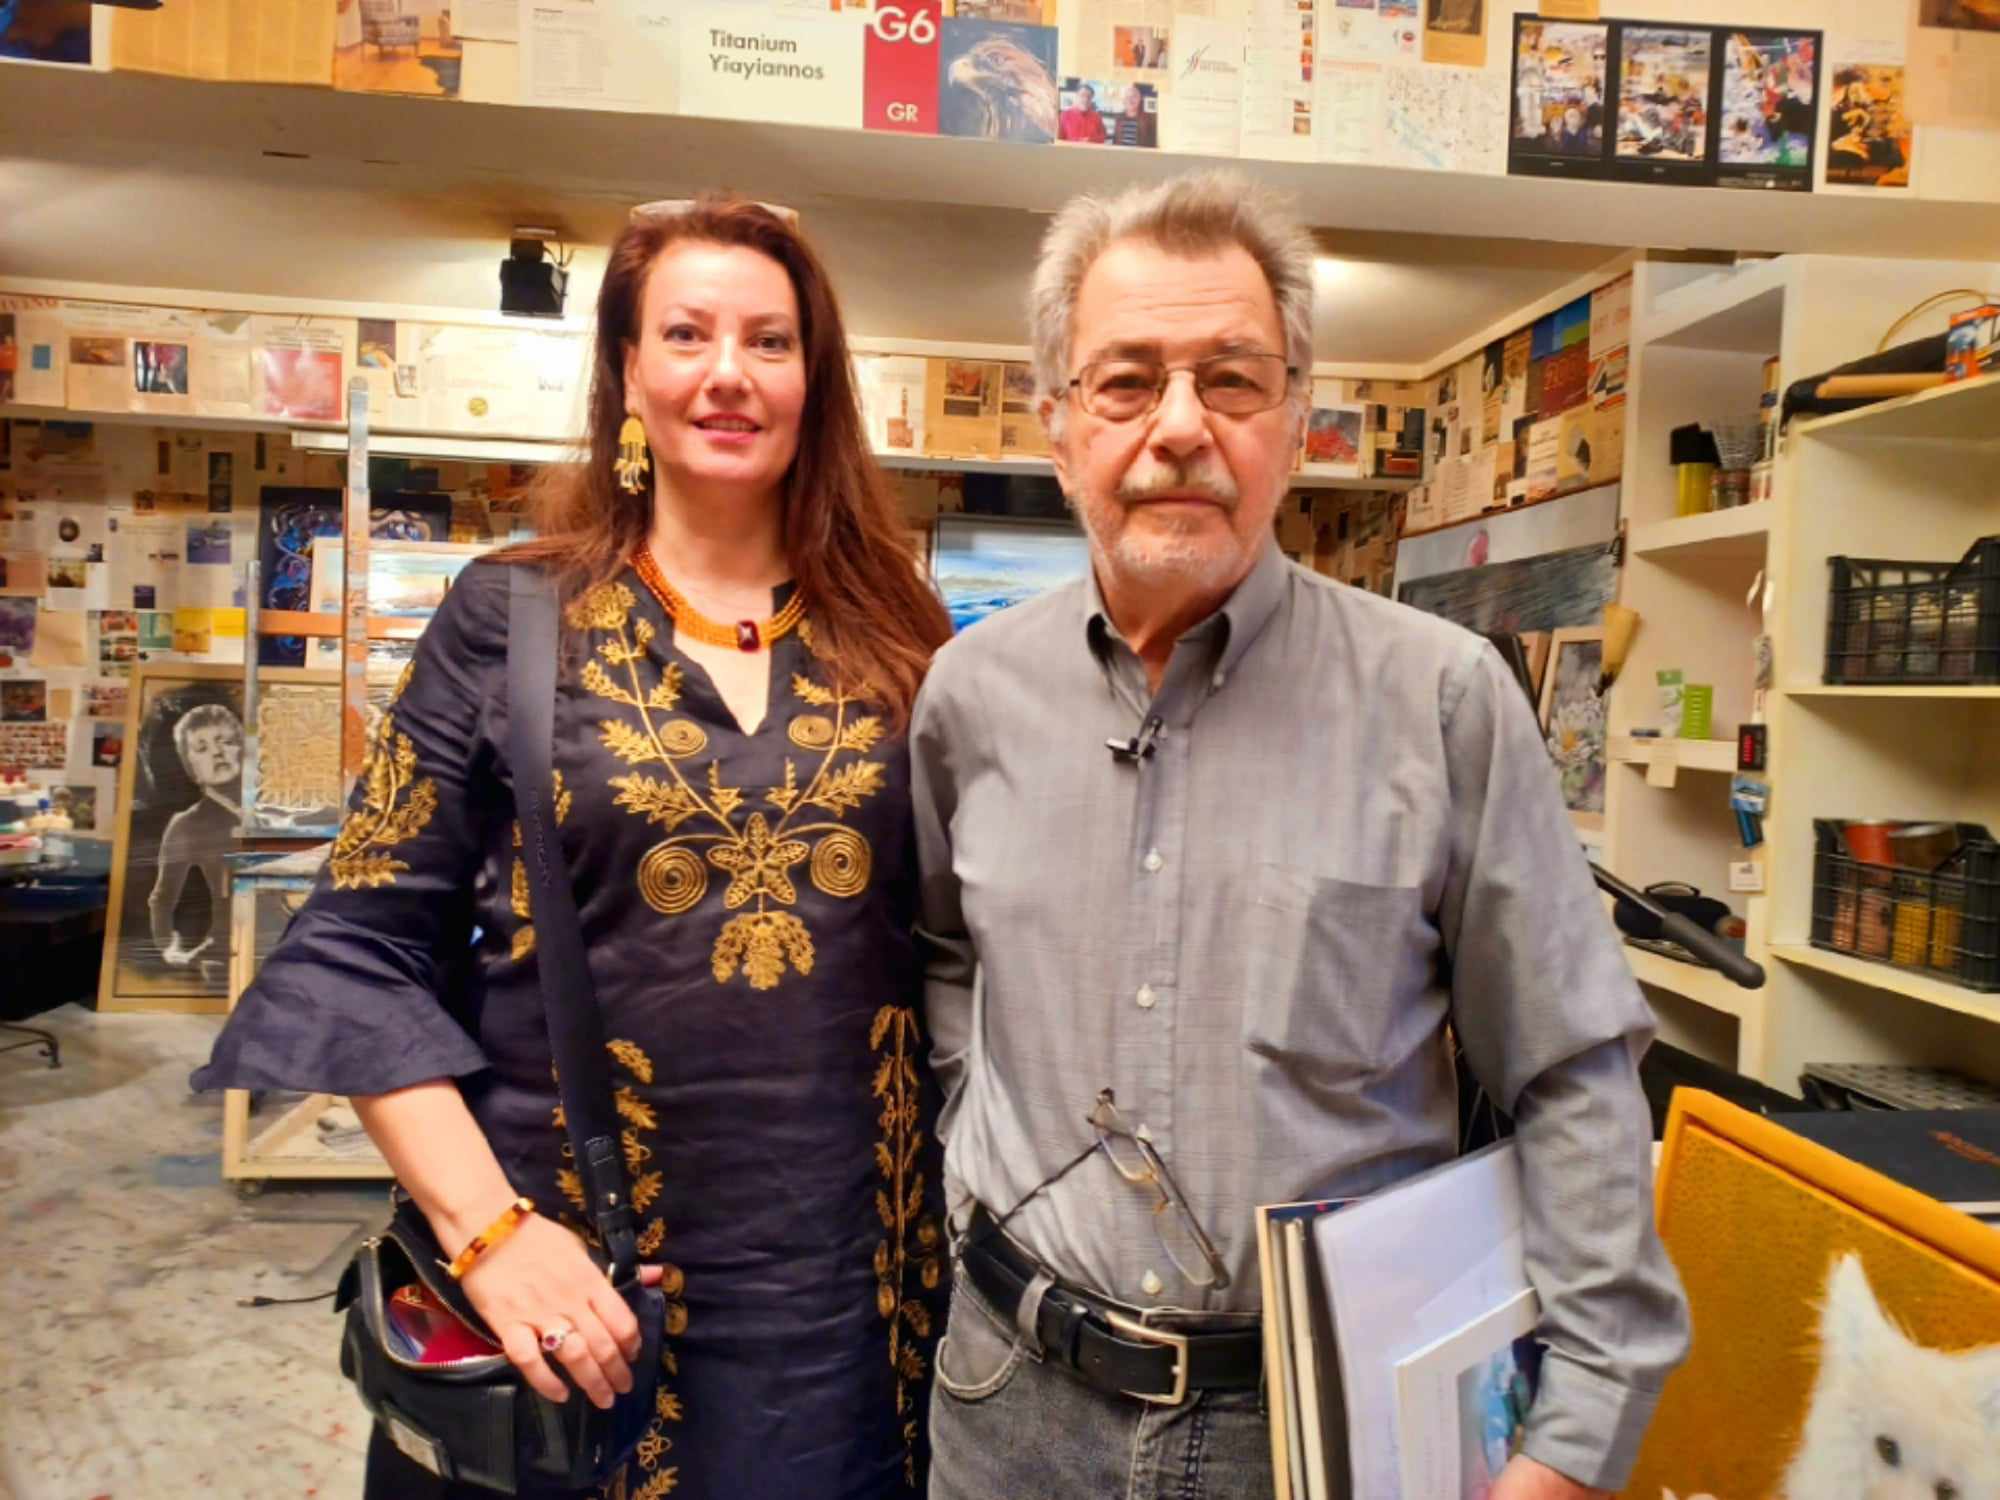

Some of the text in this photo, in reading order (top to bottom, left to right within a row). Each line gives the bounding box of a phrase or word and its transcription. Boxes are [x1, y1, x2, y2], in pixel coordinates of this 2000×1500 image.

[873, 6, 936, 44] G6
[709, 29, 798, 53] Titanium
[709, 54, 824, 80] Yiayiannos
[886, 102, 919, 122] GR
